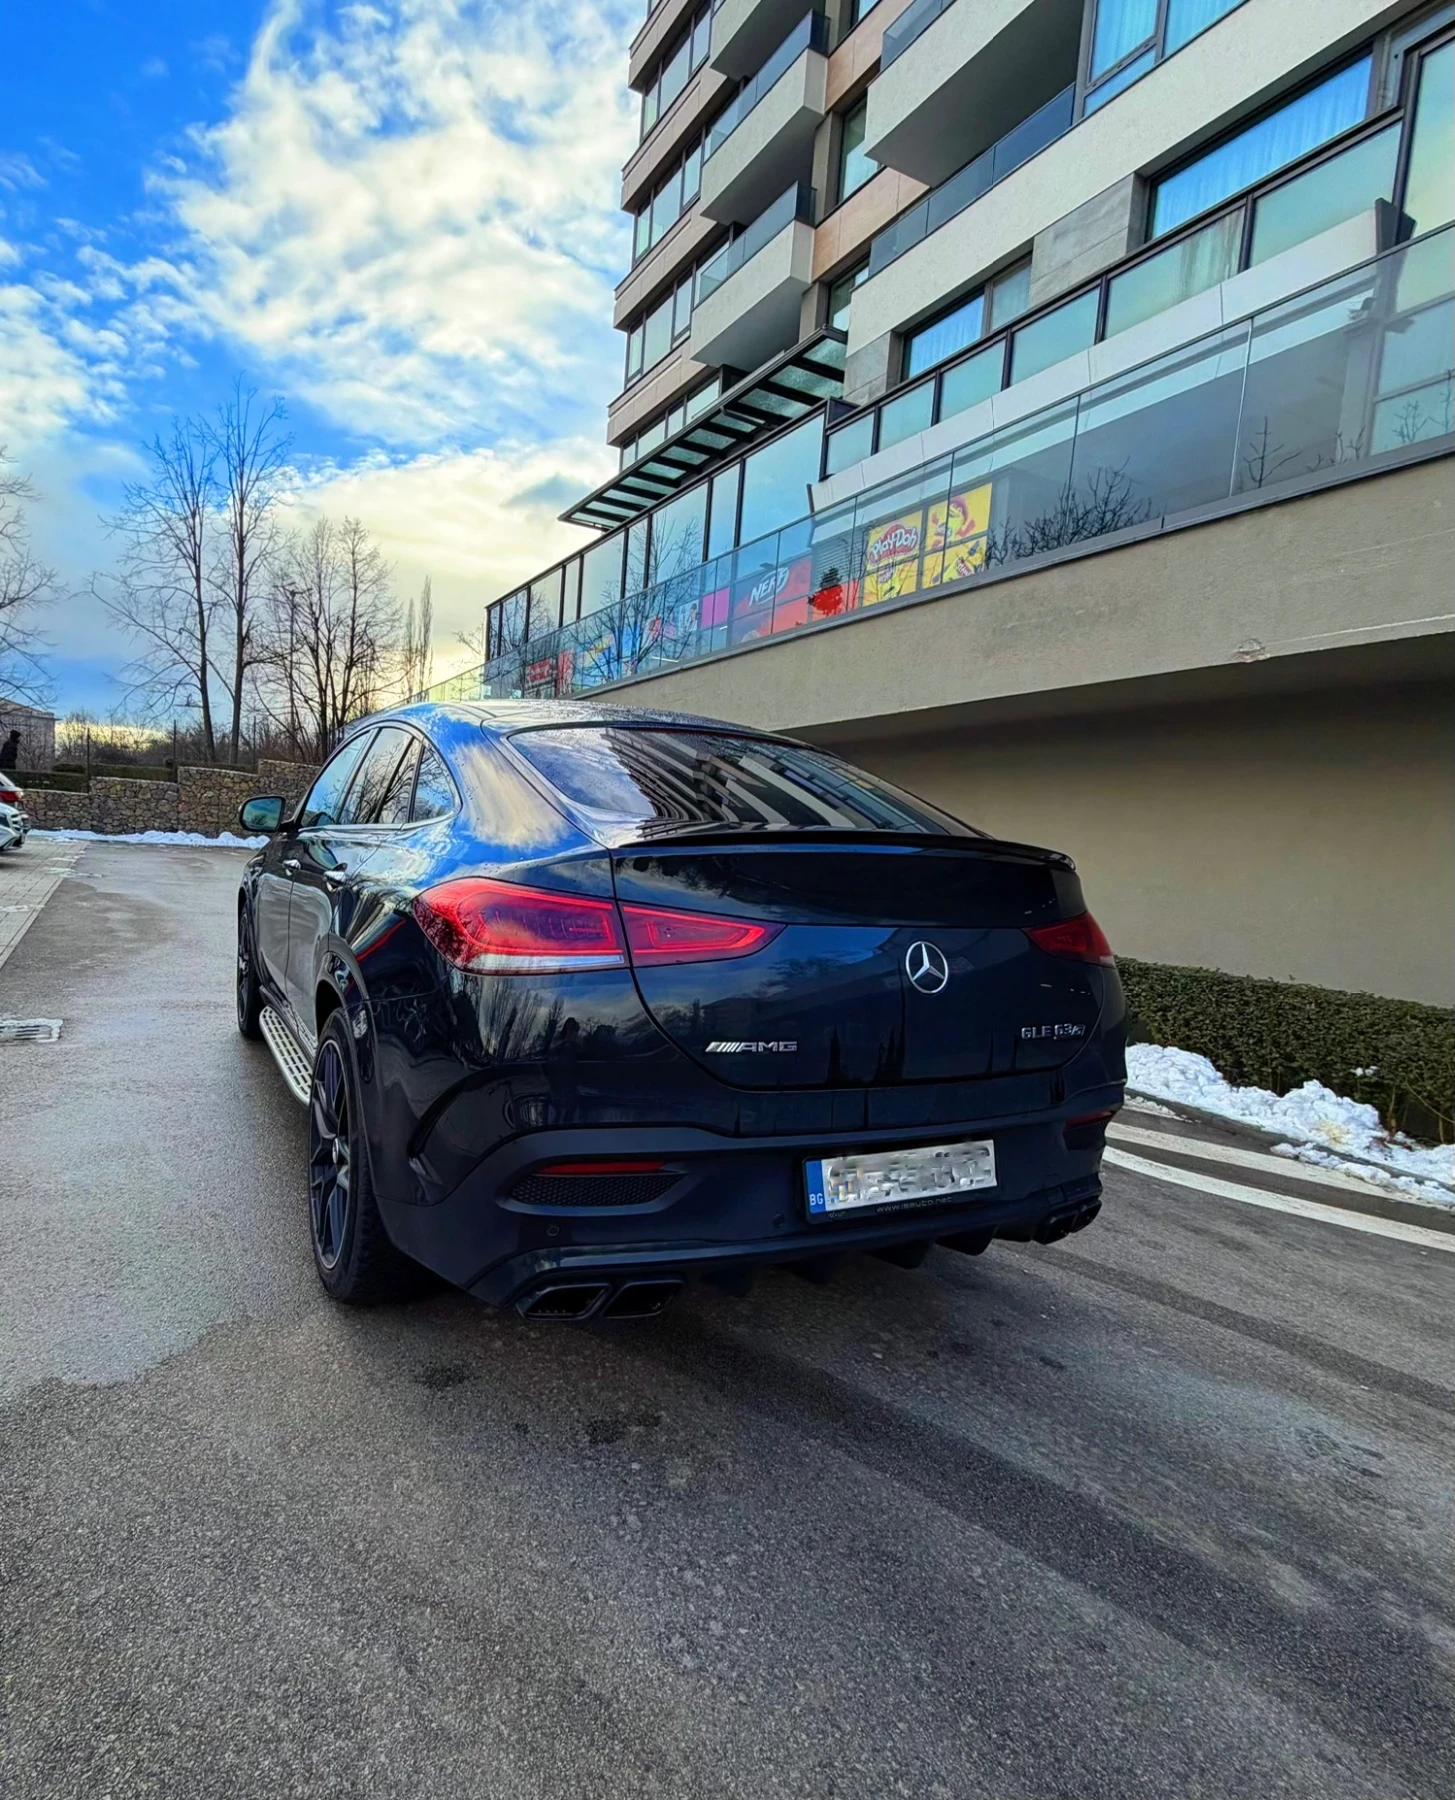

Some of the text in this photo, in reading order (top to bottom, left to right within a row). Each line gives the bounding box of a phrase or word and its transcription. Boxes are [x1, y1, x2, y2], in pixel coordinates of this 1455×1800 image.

[748, 568, 788, 606] NERF
[1021, 1026, 1052, 1039] GLE
[809, 1193, 824, 1206] BG
